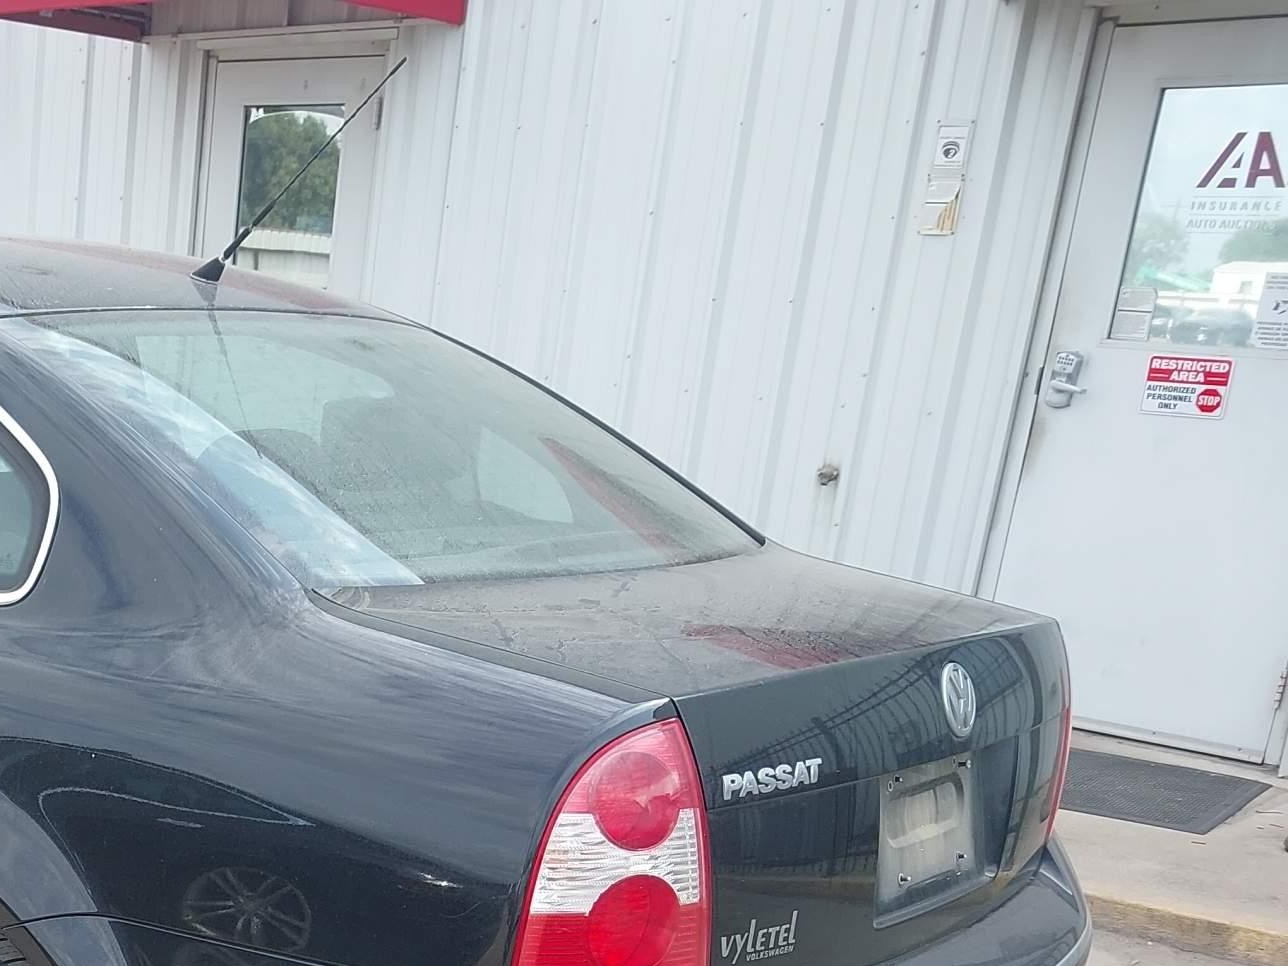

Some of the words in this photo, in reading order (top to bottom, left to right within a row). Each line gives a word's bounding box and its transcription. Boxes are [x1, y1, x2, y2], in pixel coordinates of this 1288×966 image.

[1192, 201, 1282, 211] INSURANCE
[1186, 219, 1216, 229] AUTO
[1151, 358, 1230, 373] RESTRICTED
[1169, 371, 1205, 382] AREA
[1147, 385, 1197, 394] AUTHORIZED
[1146, 393, 1192, 402] PERSONNEL
[1198, 395, 1220, 406] STOP
[722, 758, 822, 800] PASSAT
[746, 945, 794, 961] VOLKSWAGEN
